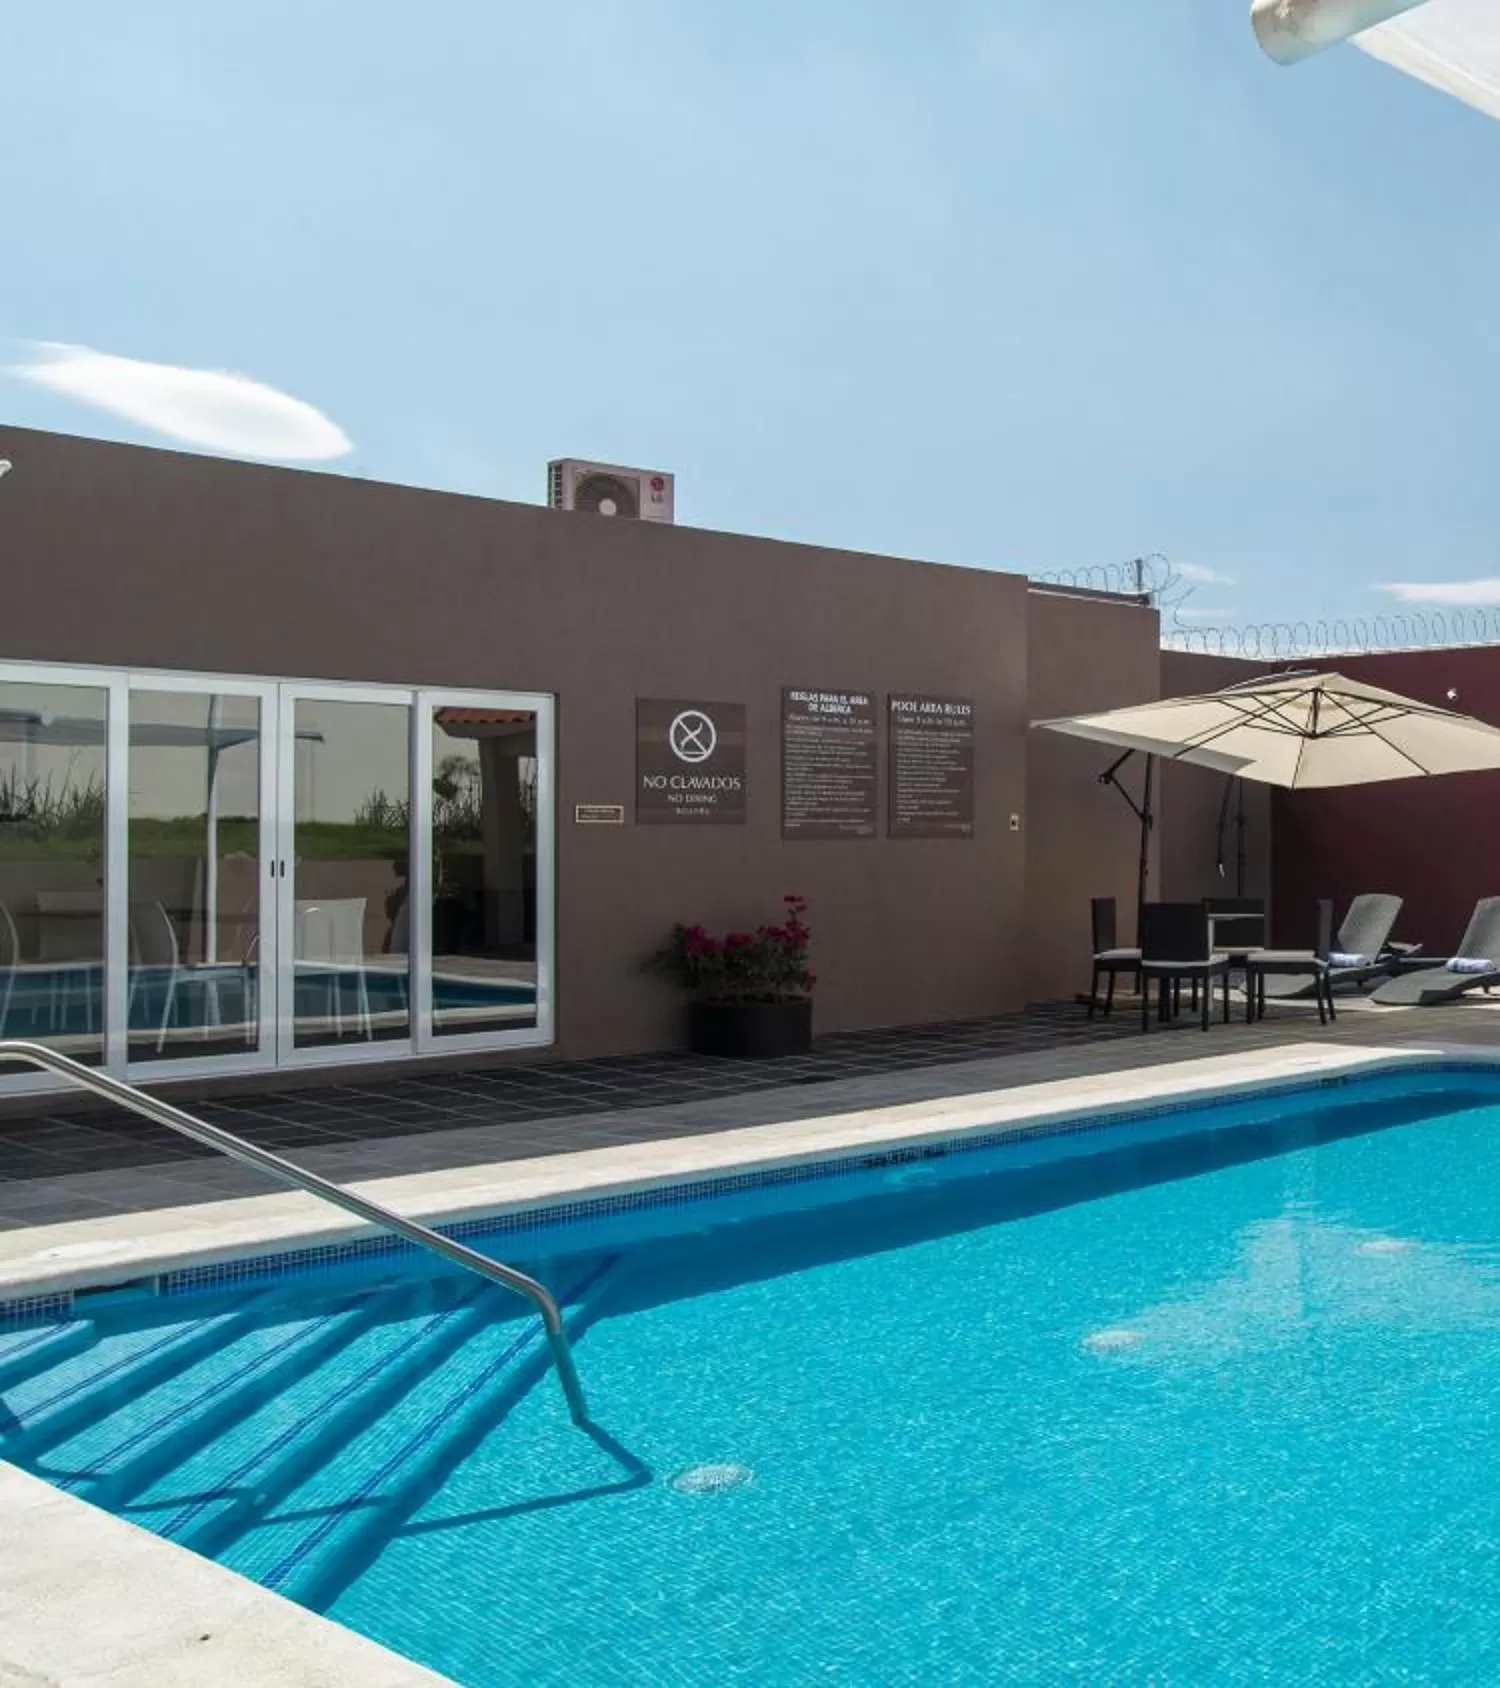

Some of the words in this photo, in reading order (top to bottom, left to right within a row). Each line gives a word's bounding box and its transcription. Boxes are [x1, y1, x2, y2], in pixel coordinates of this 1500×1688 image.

[892, 700, 916, 713] POOL
[643, 775, 667, 789] NO
[670, 775, 741, 790] CLAVADOS
[667, 794, 683, 803] NO
[686, 794, 717, 804] DIVING
